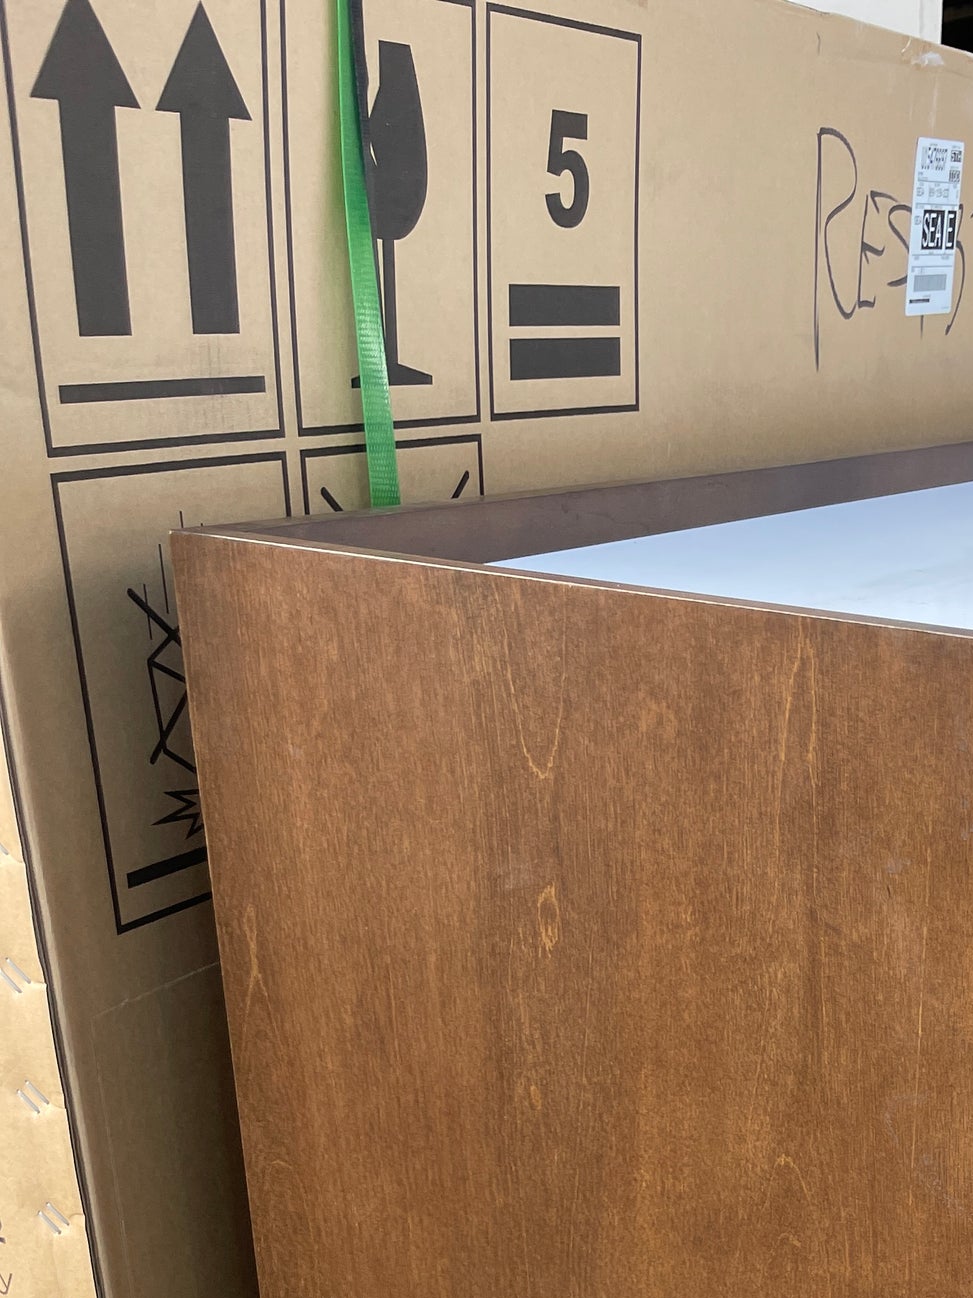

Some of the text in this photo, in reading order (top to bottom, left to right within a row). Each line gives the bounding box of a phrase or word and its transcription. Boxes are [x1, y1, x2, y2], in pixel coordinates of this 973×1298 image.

[545, 110, 591, 229] 5
[922, 211, 956, 249] SEA E
